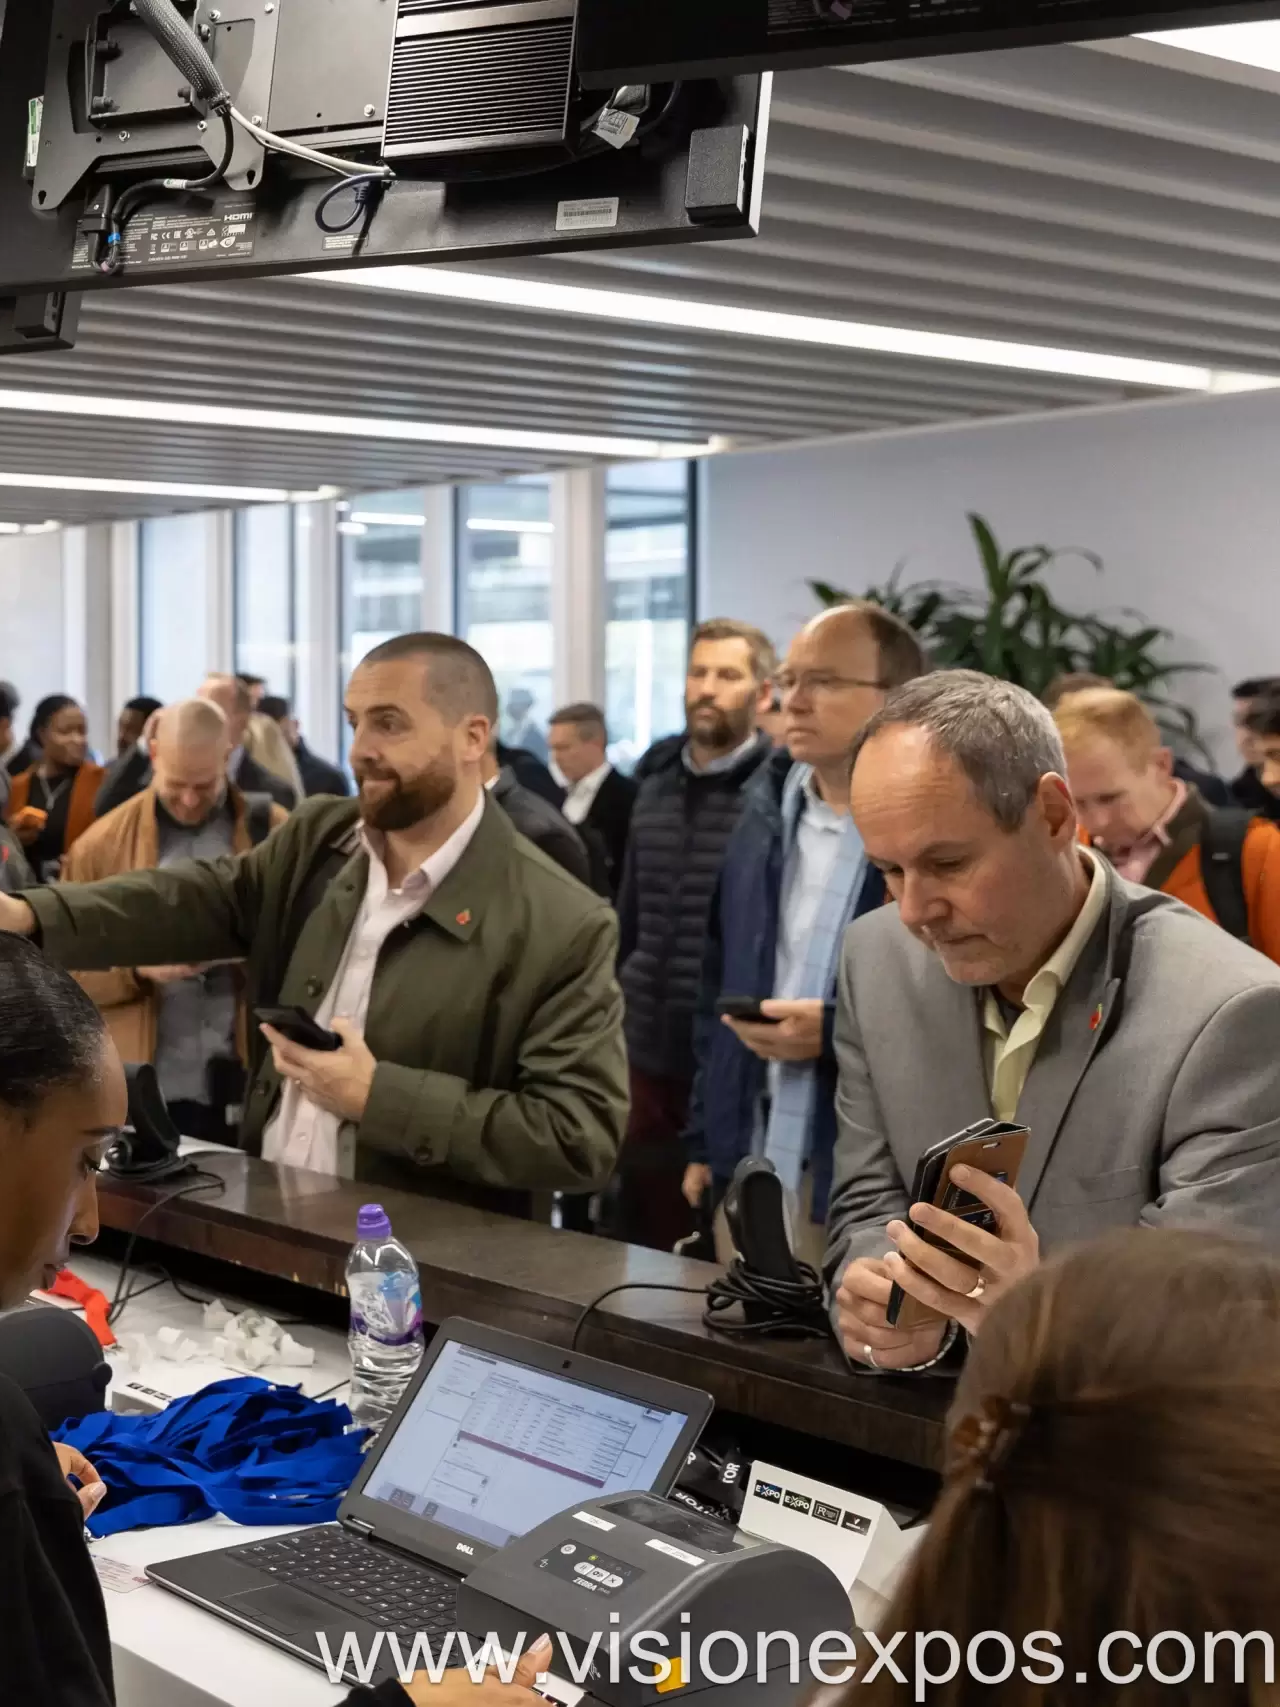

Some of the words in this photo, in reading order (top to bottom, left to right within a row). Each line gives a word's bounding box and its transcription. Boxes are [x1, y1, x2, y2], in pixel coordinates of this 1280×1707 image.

[224, 212, 253, 221] HDMI
[755, 1484, 781, 1499] EXPO
[784, 1495, 810, 1510] EXPO
[456, 1542, 475, 1556] DELL
[572, 1576, 598, 1592] ZEBRA
